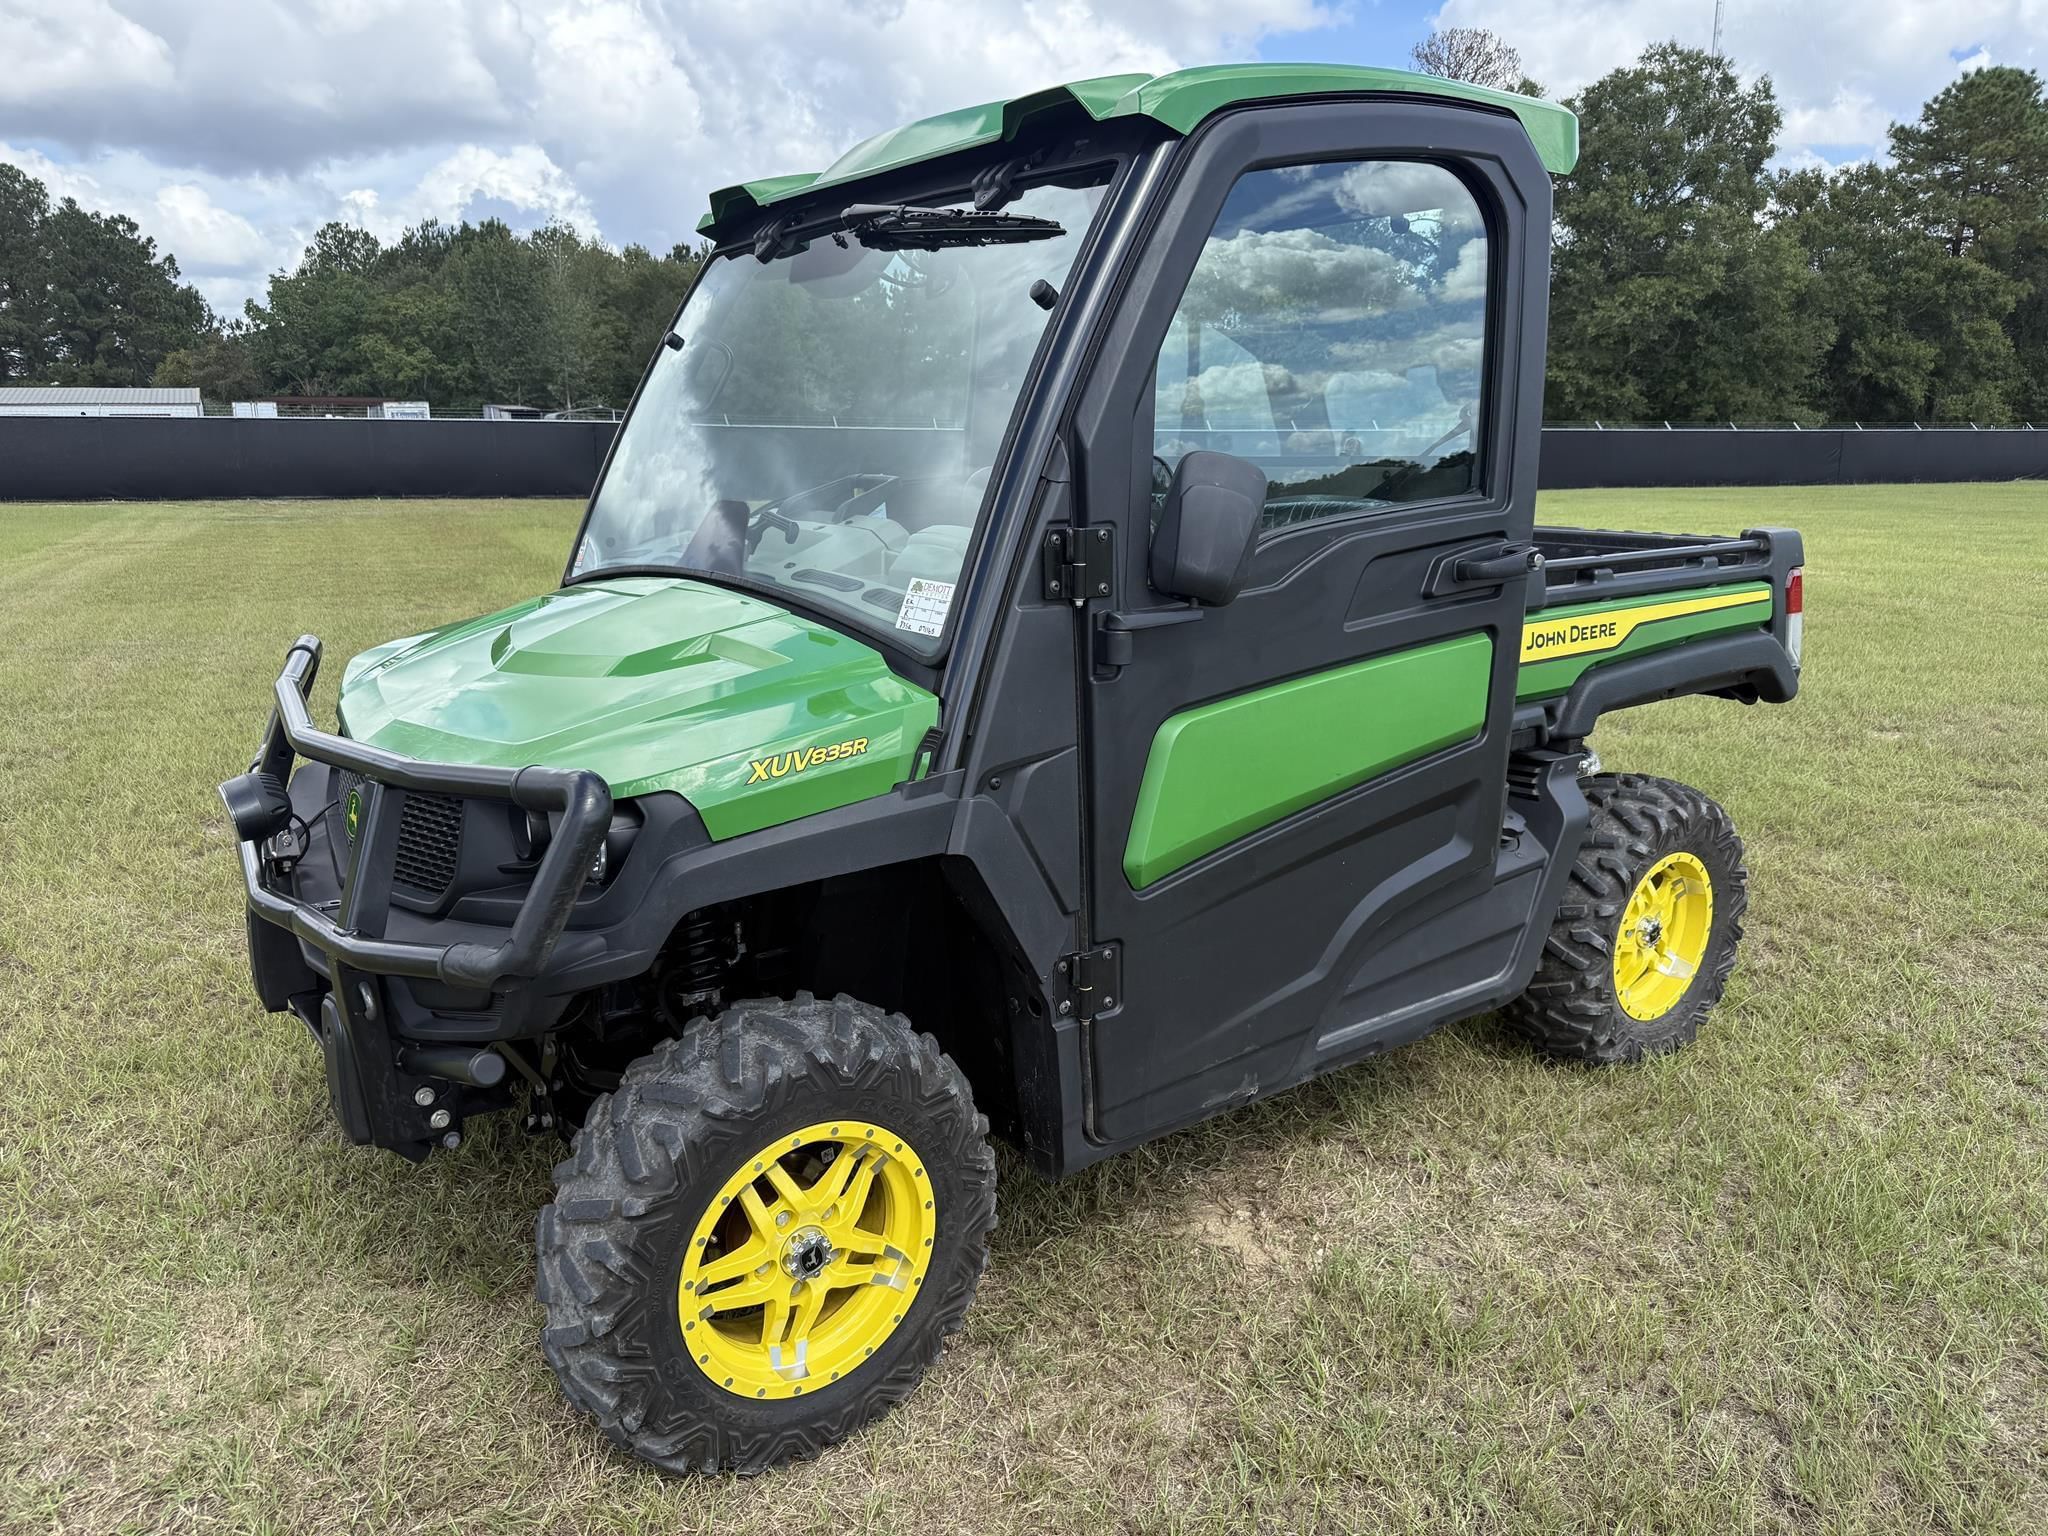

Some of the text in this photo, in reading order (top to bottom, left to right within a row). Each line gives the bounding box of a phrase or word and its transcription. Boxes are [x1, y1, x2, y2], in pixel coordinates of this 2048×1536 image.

[924, 582, 952, 594] DEMOTT
[1526, 622, 1616, 650] JOHN DEERE
[744, 737, 869, 786] XUV835R
